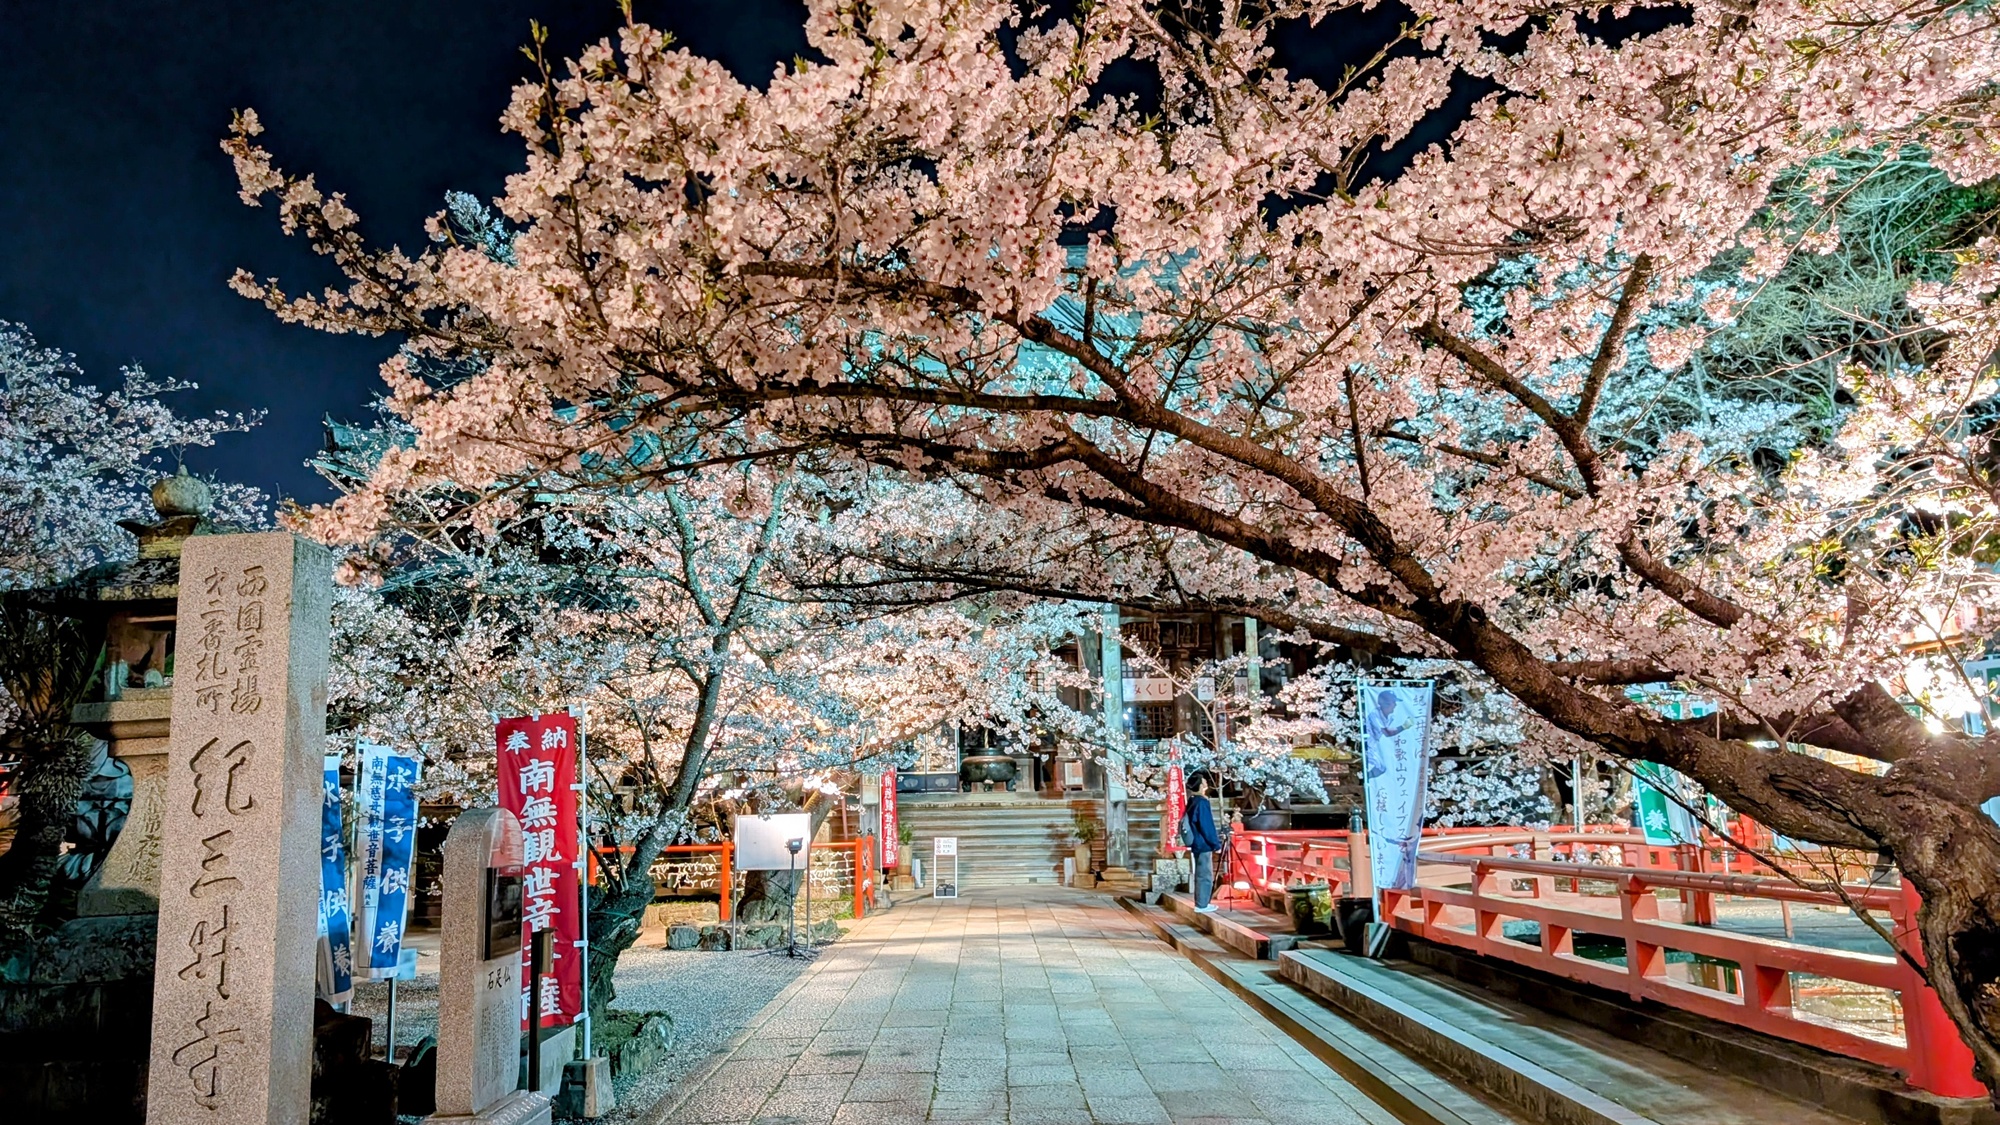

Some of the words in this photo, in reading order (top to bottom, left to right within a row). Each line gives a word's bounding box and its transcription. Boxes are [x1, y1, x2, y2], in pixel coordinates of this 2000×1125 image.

[504, 725, 568, 755] 奉納
[375, 765, 413, 954] 水子供養
[520, 758, 563, 1020] 南無観世音薩
